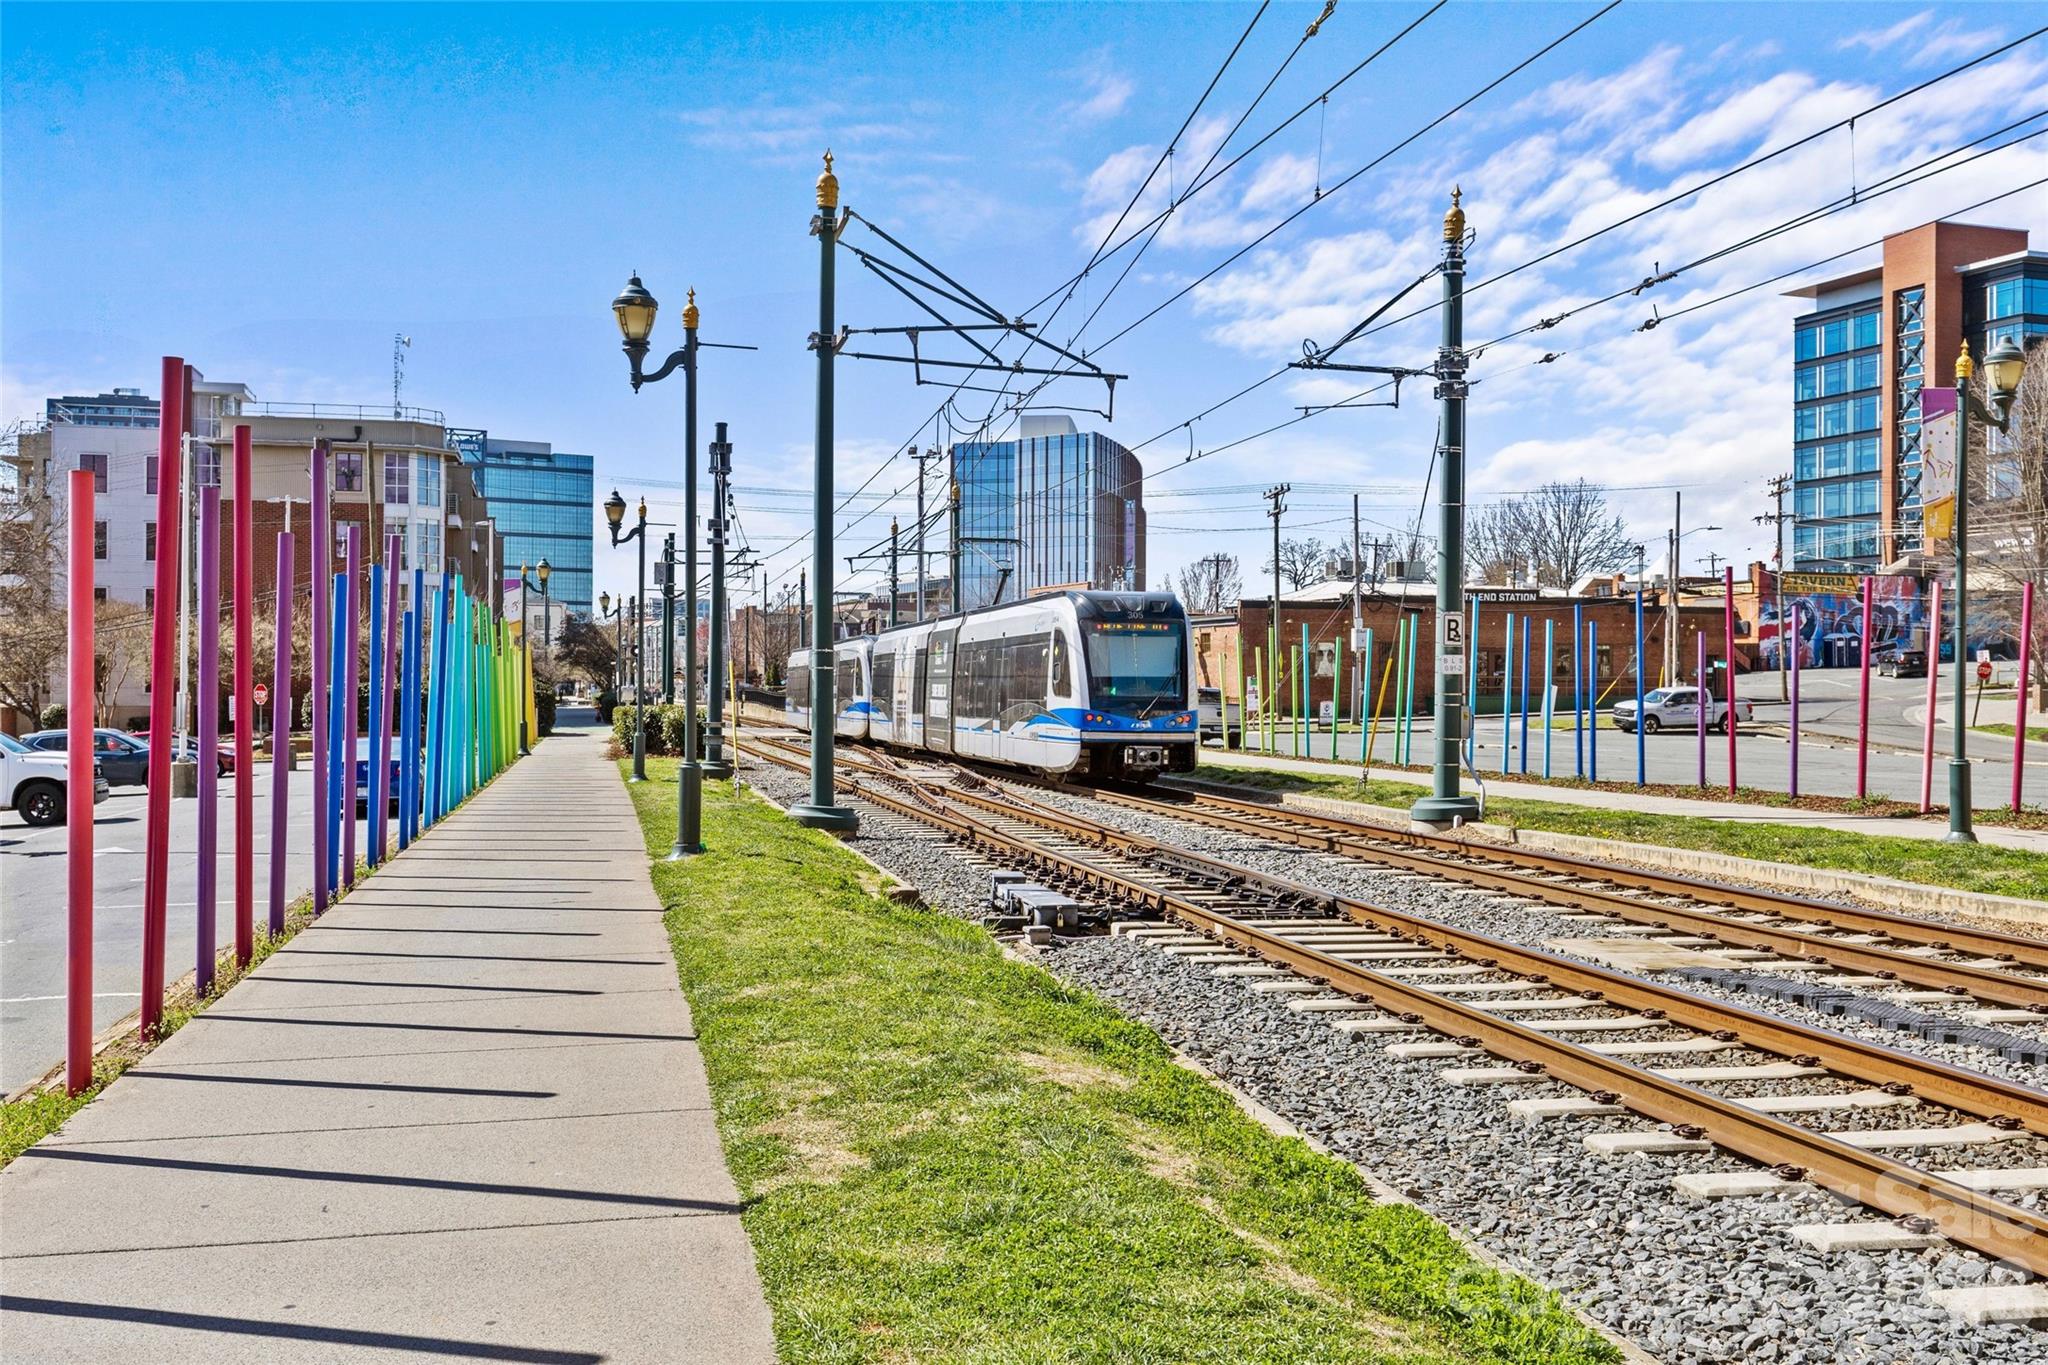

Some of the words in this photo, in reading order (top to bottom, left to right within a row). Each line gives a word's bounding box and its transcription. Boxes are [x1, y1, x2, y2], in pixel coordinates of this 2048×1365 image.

[1791, 575, 1846, 586] TAVERN
[1478, 592, 1497, 601] END
[1498, 592, 1537, 601] STATION
